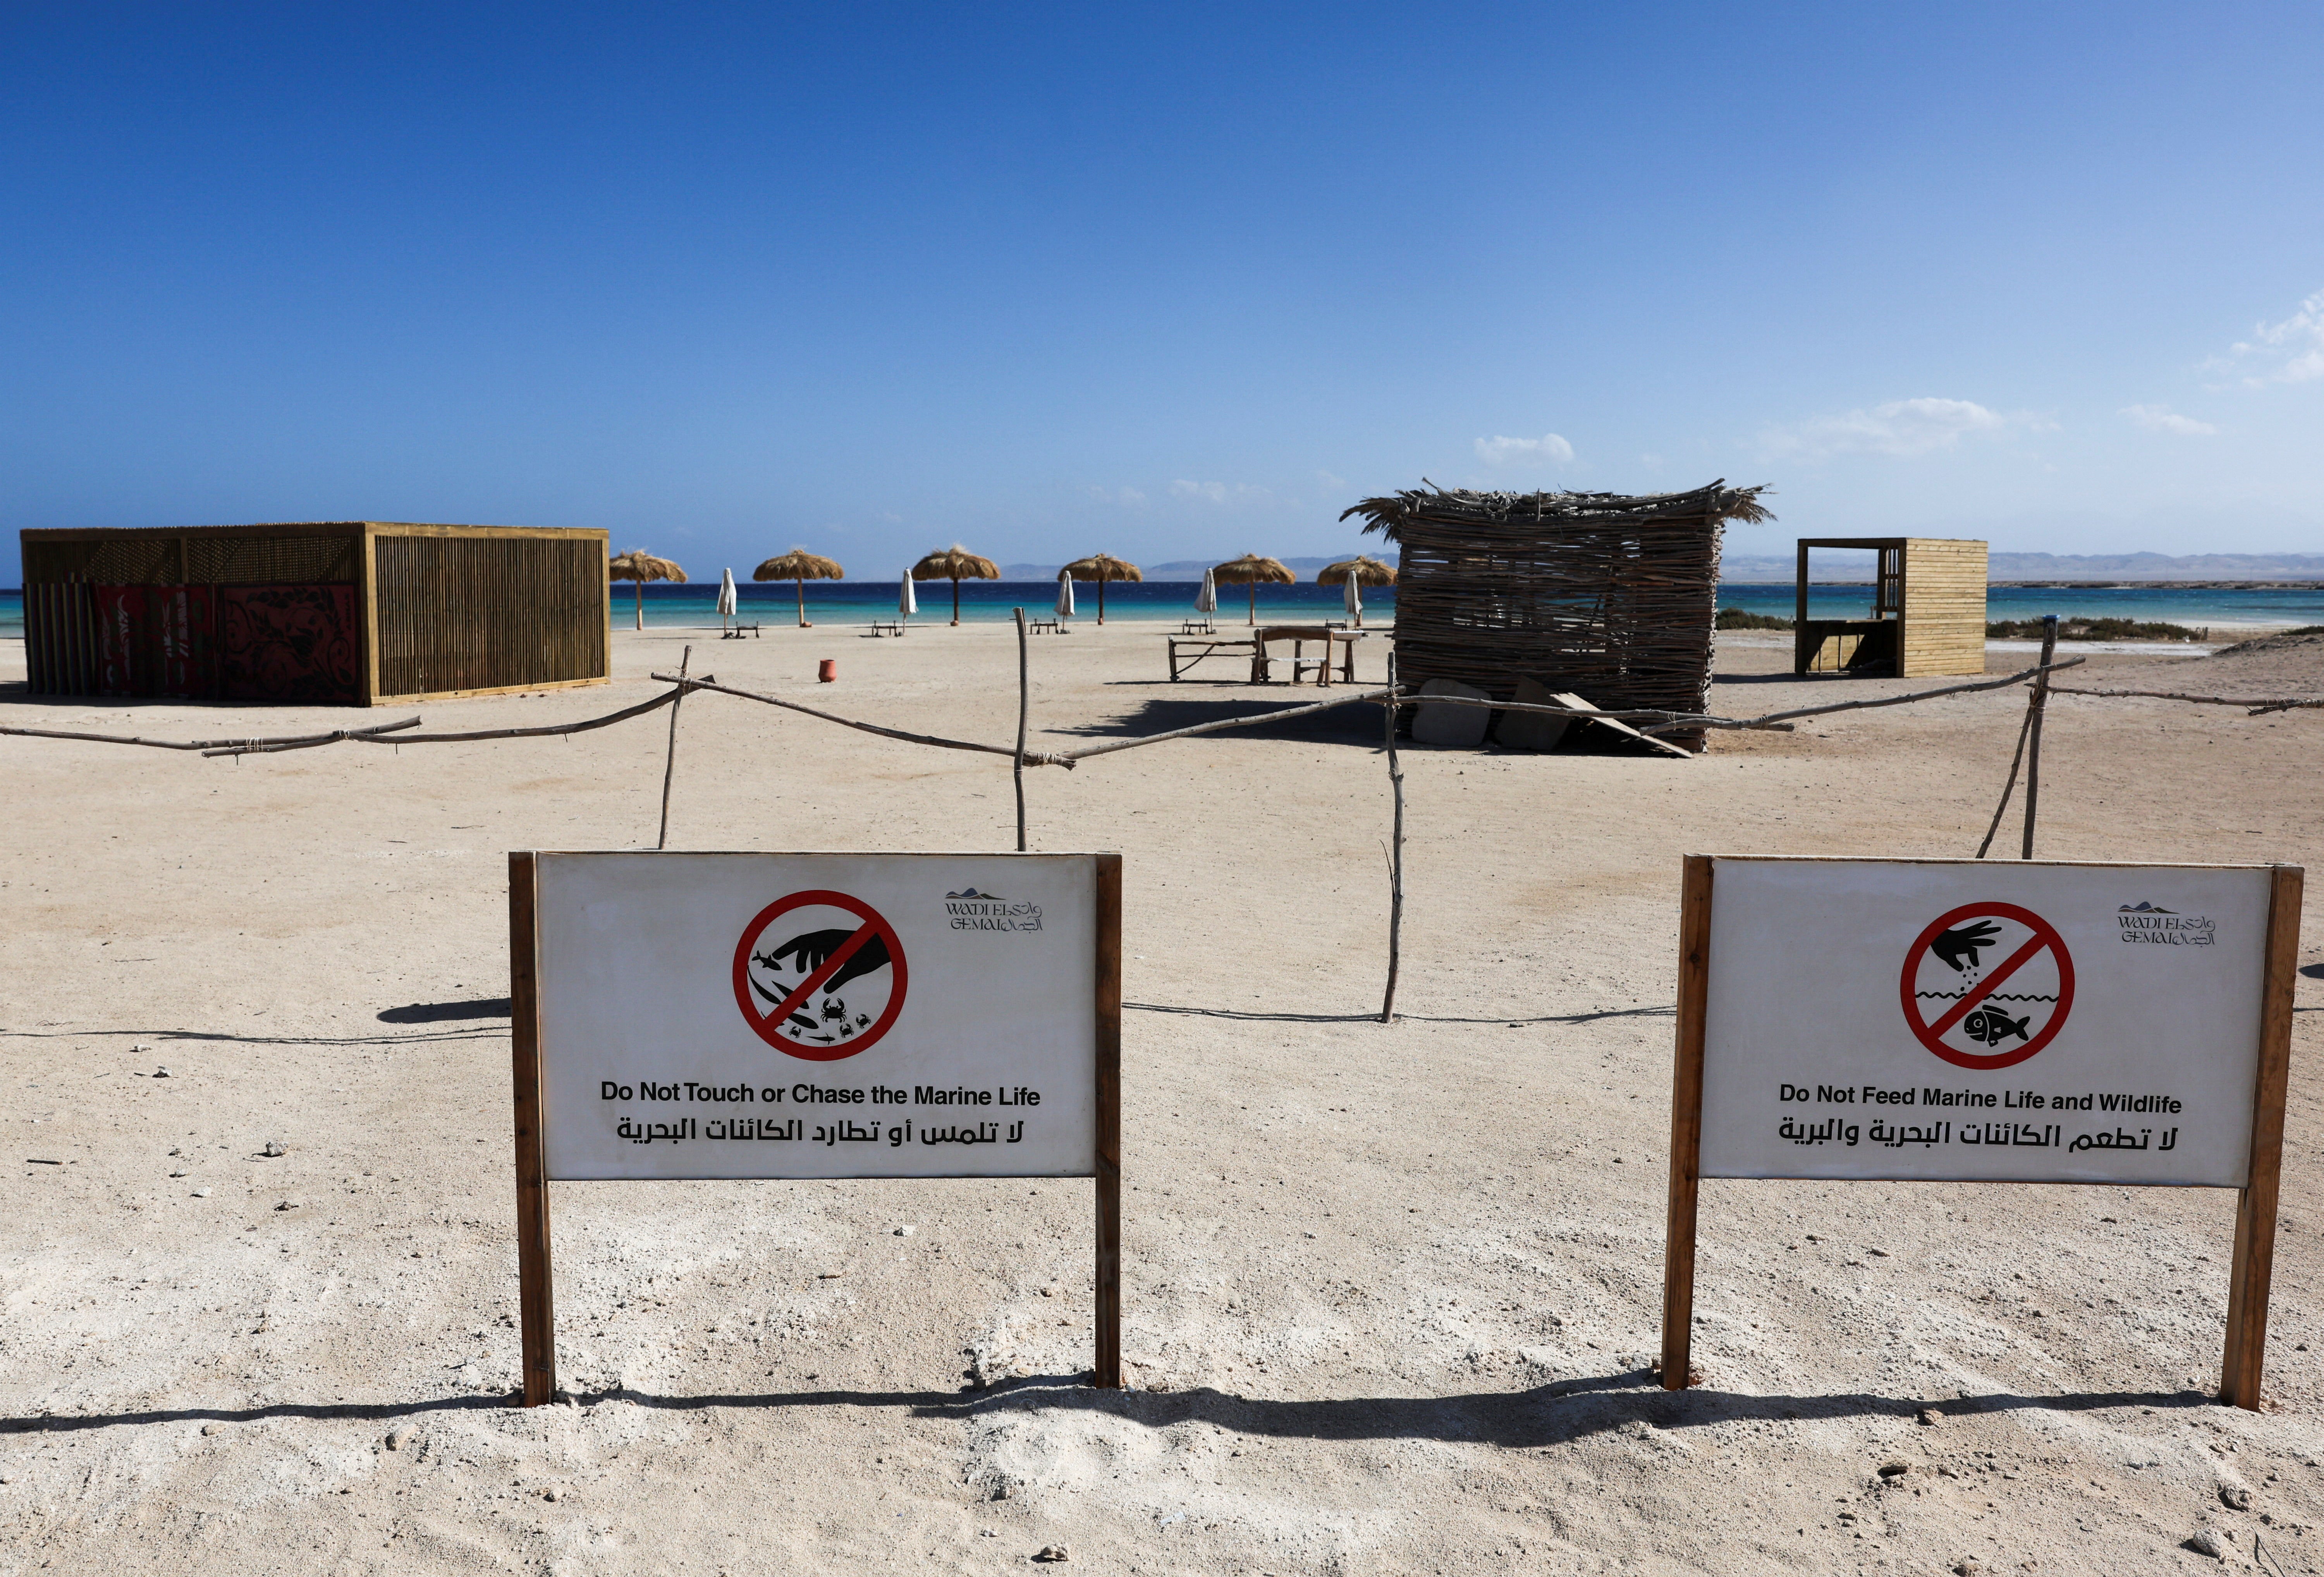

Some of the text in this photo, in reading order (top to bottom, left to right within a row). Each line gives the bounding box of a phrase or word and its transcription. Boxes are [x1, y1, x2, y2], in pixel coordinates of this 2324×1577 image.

[945, 903, 988, 915] WADI
[2118, 916, 2160, 928] WADI
[602, 1081, 1040, 1106] Do Not Touch or Chase the Marine Life
[1780, 1084, 2182, 1114] Do Not Feed Marine Life and Wildlife
[617, 1117, 1024, 1147] لا تلمس أو تطارد الكائنات البحرية
[1779, 1117, 2178, 1153] لا تطعم الكائنات البحرية والبرية
